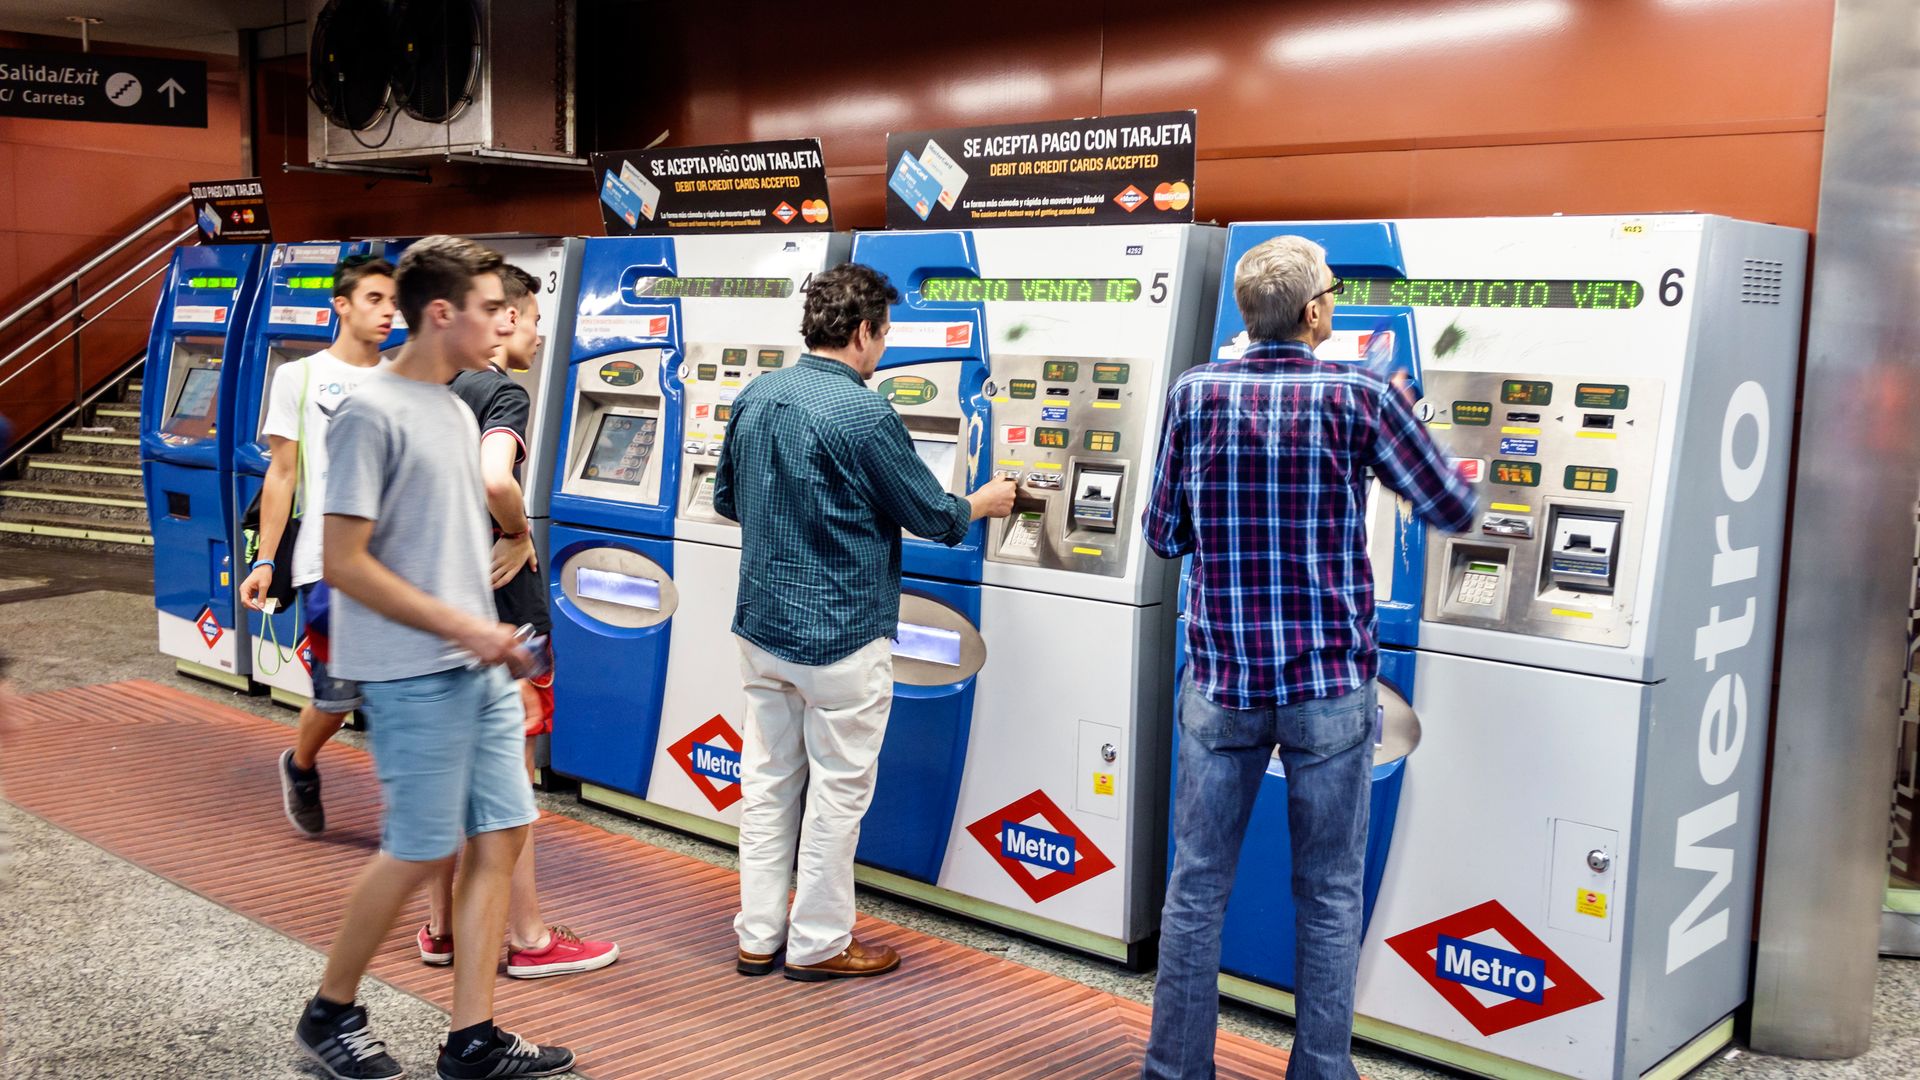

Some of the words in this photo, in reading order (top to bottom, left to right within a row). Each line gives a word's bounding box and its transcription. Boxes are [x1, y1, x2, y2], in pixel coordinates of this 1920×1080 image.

[0, 64, 100, 86] Salida/Exit
[0, 88, 14, 102] C/
[22, 90, 86, 106] Carretas
[964, 138, 982, 158] SE
[984, 134, 1038, 156] ACEPTA
[1042, 131, 1080, 153] PAGO
[1084, 128, 1116, 150] CON
[1120, 124, 1192, 148] TARJETA
[651, 160, 664, 176] SE
[668, 157, 708, 175] ACEPTA
[709, 155, 739, 173] PAGO
[741, 153, 766, 172] CON
[767, 150, 821, 169] TARJETA
[990, 162, 1016, 176] DEBIT
[1018, 161, 1032, 175] OR
[1034, 159, 1068, 174] CREDIT
[1070, 157, 1103, 172] CARDS
[1105, 154, 1158, 170] ACCEPTED
[192, 187, 207, 199] SOLO
[223, 185, 236, 197] CON
[236, 183, 263, 196] TARJETA
[675, 181, 695, 192] DEBIT
[696, 180, 707, 191] OR
[708, 179, 733, 191] CREDIT
[734, 178, 759, 190] CARDS
[760, 176, 800, 188] ACCEPTED
[998, 198, 1019, 207] cómoda
[1042, 197, 1049, 205] de
[1073, 197, 1083, 205] por
[1084, 194, 1104, 203] Madrid
[547, 270, 556, 294] 3
[1021, 280, 1092, 302] VENTA
[1106, 280, 1137, 302] DE
[1150, 272, 1168, 304] 5
[1390, 281, 1548, 308] SERVICIO
[1572, 281, 1638, 309] VEN
[1658, 268, 1685, 306] 6
[1666, 380, 1770, 975] Metro
[697, 748, 741, 778] Metro
[1007, 828, 1070, 866] Metro
[1444, 944, 1536, 993] Metro
